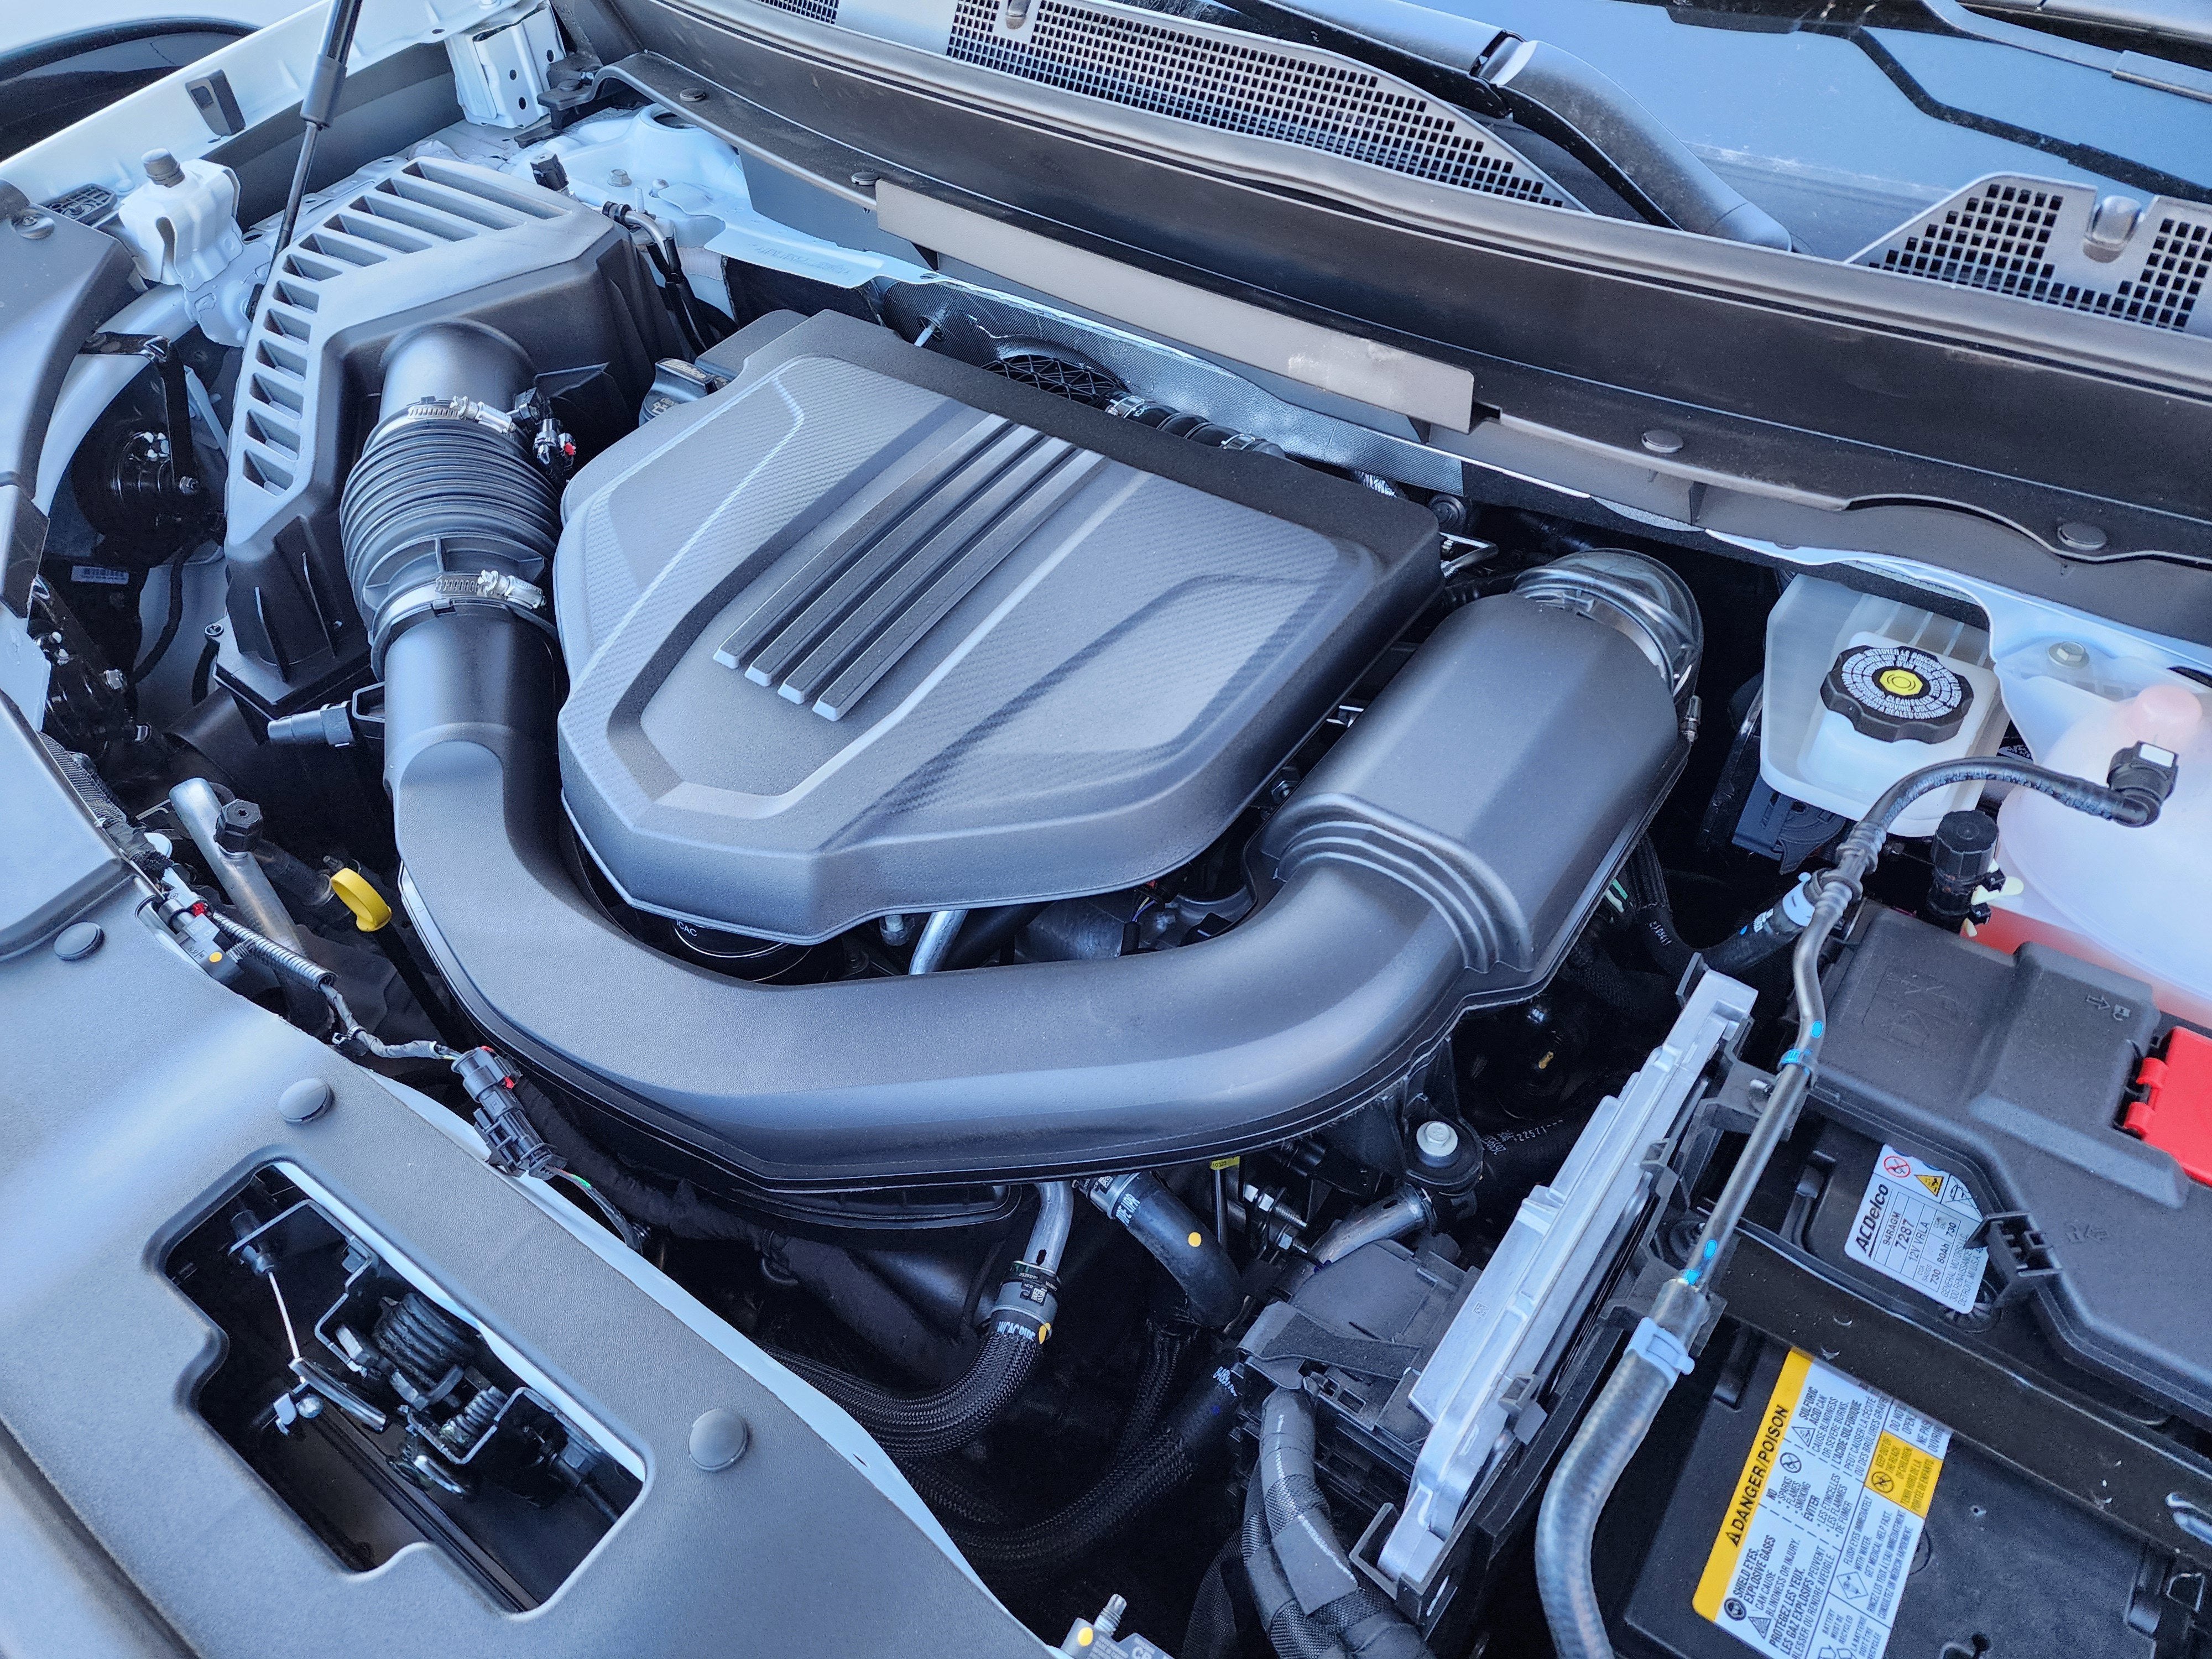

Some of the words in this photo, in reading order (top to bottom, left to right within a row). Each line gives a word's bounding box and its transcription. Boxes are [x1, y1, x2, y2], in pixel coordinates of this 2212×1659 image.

[1855, 1183, 1888, 1253] ACDelco
[1882, 1211, 1901, 1246] 94RAGM
[1945, 1220, 1957, 1238] 730
[1894, 1218, 1915, 1251] 7287
[1913, 1219, 1930, 1246] VRLA
[1907, 1244, 1921, 1263] 12V
[1936, 1241, 1950, 1264] 80Ah
[1929, 1267, 1941, 1285] 730
[1940, 1269, 1956, 1298] GENERAL
[1949, 1245, 1964, 1270] MOTORS
[1953, 1249, 1973, 1291] RENAISSANCE
[1949, 1289, 1959, 1302] 300
[1798, 1385, 1819, 1421] SULFURIC
[1815, 1393, 1828, 1409] CAN
[1818, 1395, 1839, 1433] BLINDNESS
[1833, 1399, 1849, 1425] BURNS.
[1859, 1394, 1877, 1420] CÉCITÉ
[1808, 1406, 1823, 1426] ACID
[1839, 1399, 1863, 1441] SULFURIQUE
[1858, 1417, 1869, 1429] LA
[1888, 1418, 1901, 1432] DO
[1811, 1429, 1827, 1453] CAUSE
[1824, 1421, 1841, 1448] SEVERE
[1849, 1426, 1866, 1454] CAUSER
[1915, 1432, 1928, 1446] NE
[1821, 1446, 1832, 1459] OR
[1831, 1437, 1848, 1465] L'ACIDE
[1843, 1452, 1857, 1471] PEUT
[1858, 1451, 1869, 1467] DES
[1730, 1404, 1790, 1533] DANGER/POISON
[1854, 1463, 1865, 1477] OU
[1765, 1487, 1778, 1501] NO
[1776, 1475, 1793, 1502] SPARKS
[1785, 1480, 1802, 1506] FLAMES
[1793, 1480, 1812, 1511] SMOKING
[1819, 1471, 1841, 1512] ÉTINCELLES
[1829, 1483, 1848, 1516] FLAMMES
[1801, 1492, 1820, 1522] ÉVITER
[1816, 1509, 1828, 1524] LES
[1837, 1499, 1853, 1525] FUMER
[1853, 1494, 1873, 1533] IMMEDIATELY
[1825, 1514, 1837, 1529] LES
[1834, 1522, 1845, 1535] DE
[1875, 1524, 1887, 1542] HELP
[1783, 1536, 1801, 1566] INJURY.
[1849, 1530, 1861, 1548] EYES
[1807, 1545, 1826, 1579] PEUVENT
[1843, 1545, 1856, 1566] FLUSH
[1853, 1554, 1865, 1572] WITH
[1867, 1538, 1883, 1567] MEDICAL
[1731, 1567, 1751, 1599] SHIELD
[1743, 1545, 1760, 1571] EYES.
[1742, 1558, 1767, 1605] EXPLOSIVE
[1758, 1533, 1776, 1562] GASES
[1760, 1568, 1776, 1595] CAUSE
[1779, 1563, 1791, 1578] OR
[1788, 1564, 1806, 1590] YEUX.
[1816, 1550, 1837, 1588] AVEUGLE.
[1863, 1563, 1875, 1578] GET
[1754, 1592, 1767, 1611] CAN
[1765, 1574, 1787, 1618] BLINDNESS
[1783, 1588, 1797, 1607] LES
[1791, 1575, 1815, 1622] EXPLOSIFS
[1806, 1584, 1825, 1617] RENDRE
[1872, 1582, 1883, 1595] LES
[1766, 1602, 1792, 1649] PROTÉGEZ
[1785, 1618, 1800, 1640] GAZ
[1802, 1613, 1815, 1628] OU
[1779, 1635, 1794, 1656] LES
